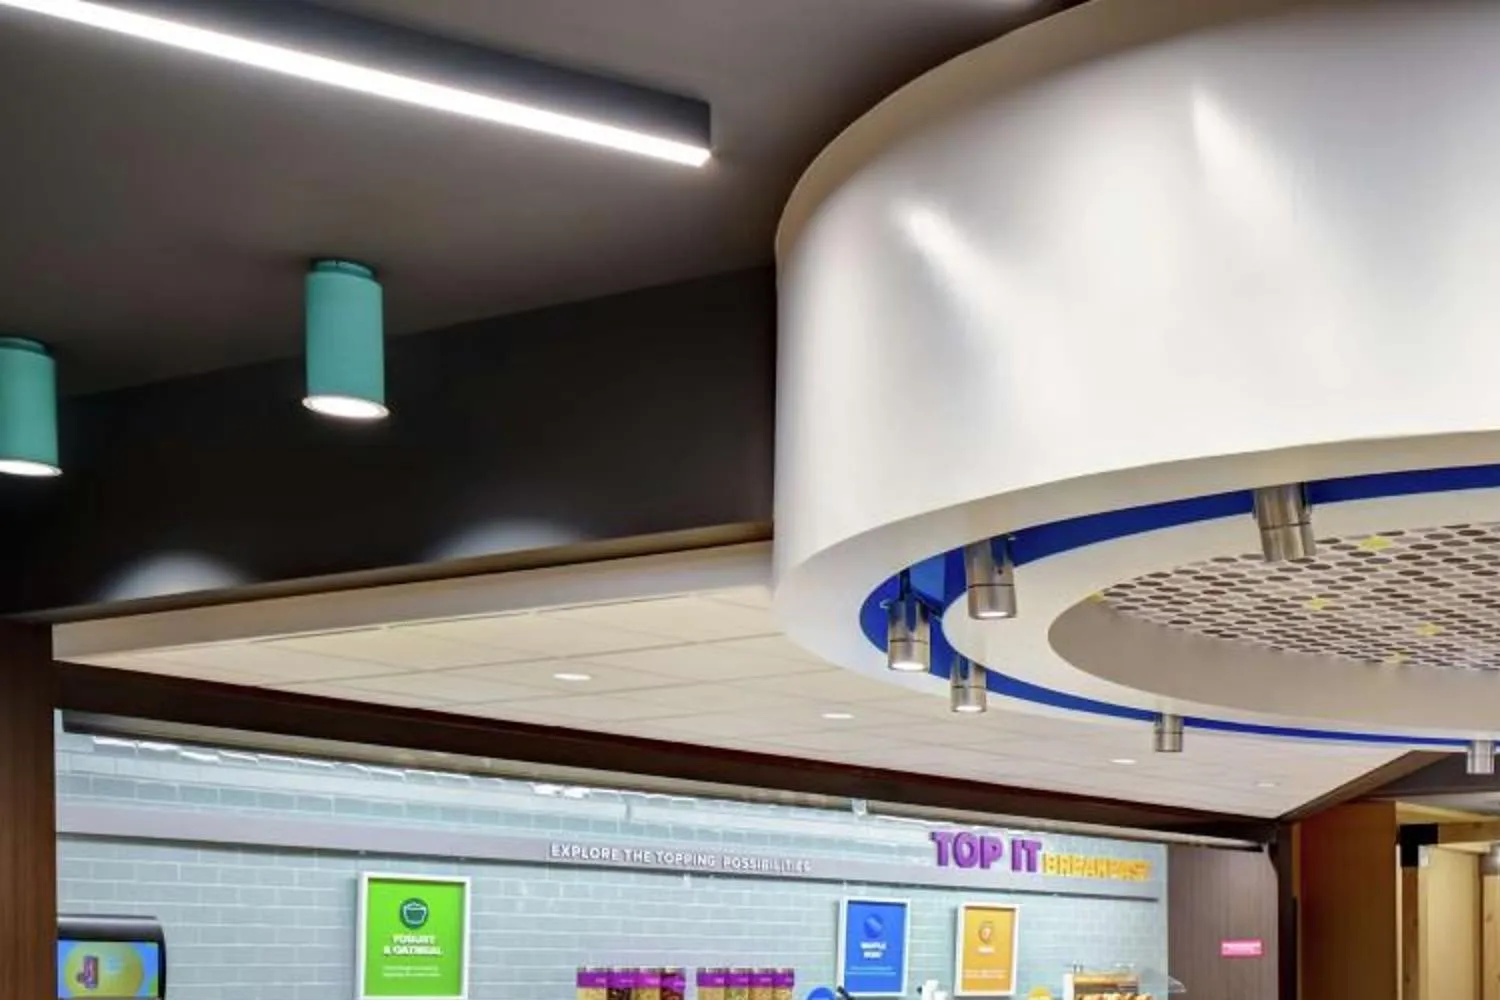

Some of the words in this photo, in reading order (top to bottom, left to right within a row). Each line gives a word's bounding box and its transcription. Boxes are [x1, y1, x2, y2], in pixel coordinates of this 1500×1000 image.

[550, 842, 620, 861] EXPLORE
[622, 848, 652, 864] THE
[655, 850, 716, 868] TOPPING
[930, 831, 1004, 869] TOP
[1011, 839, 1042, 873] IT
